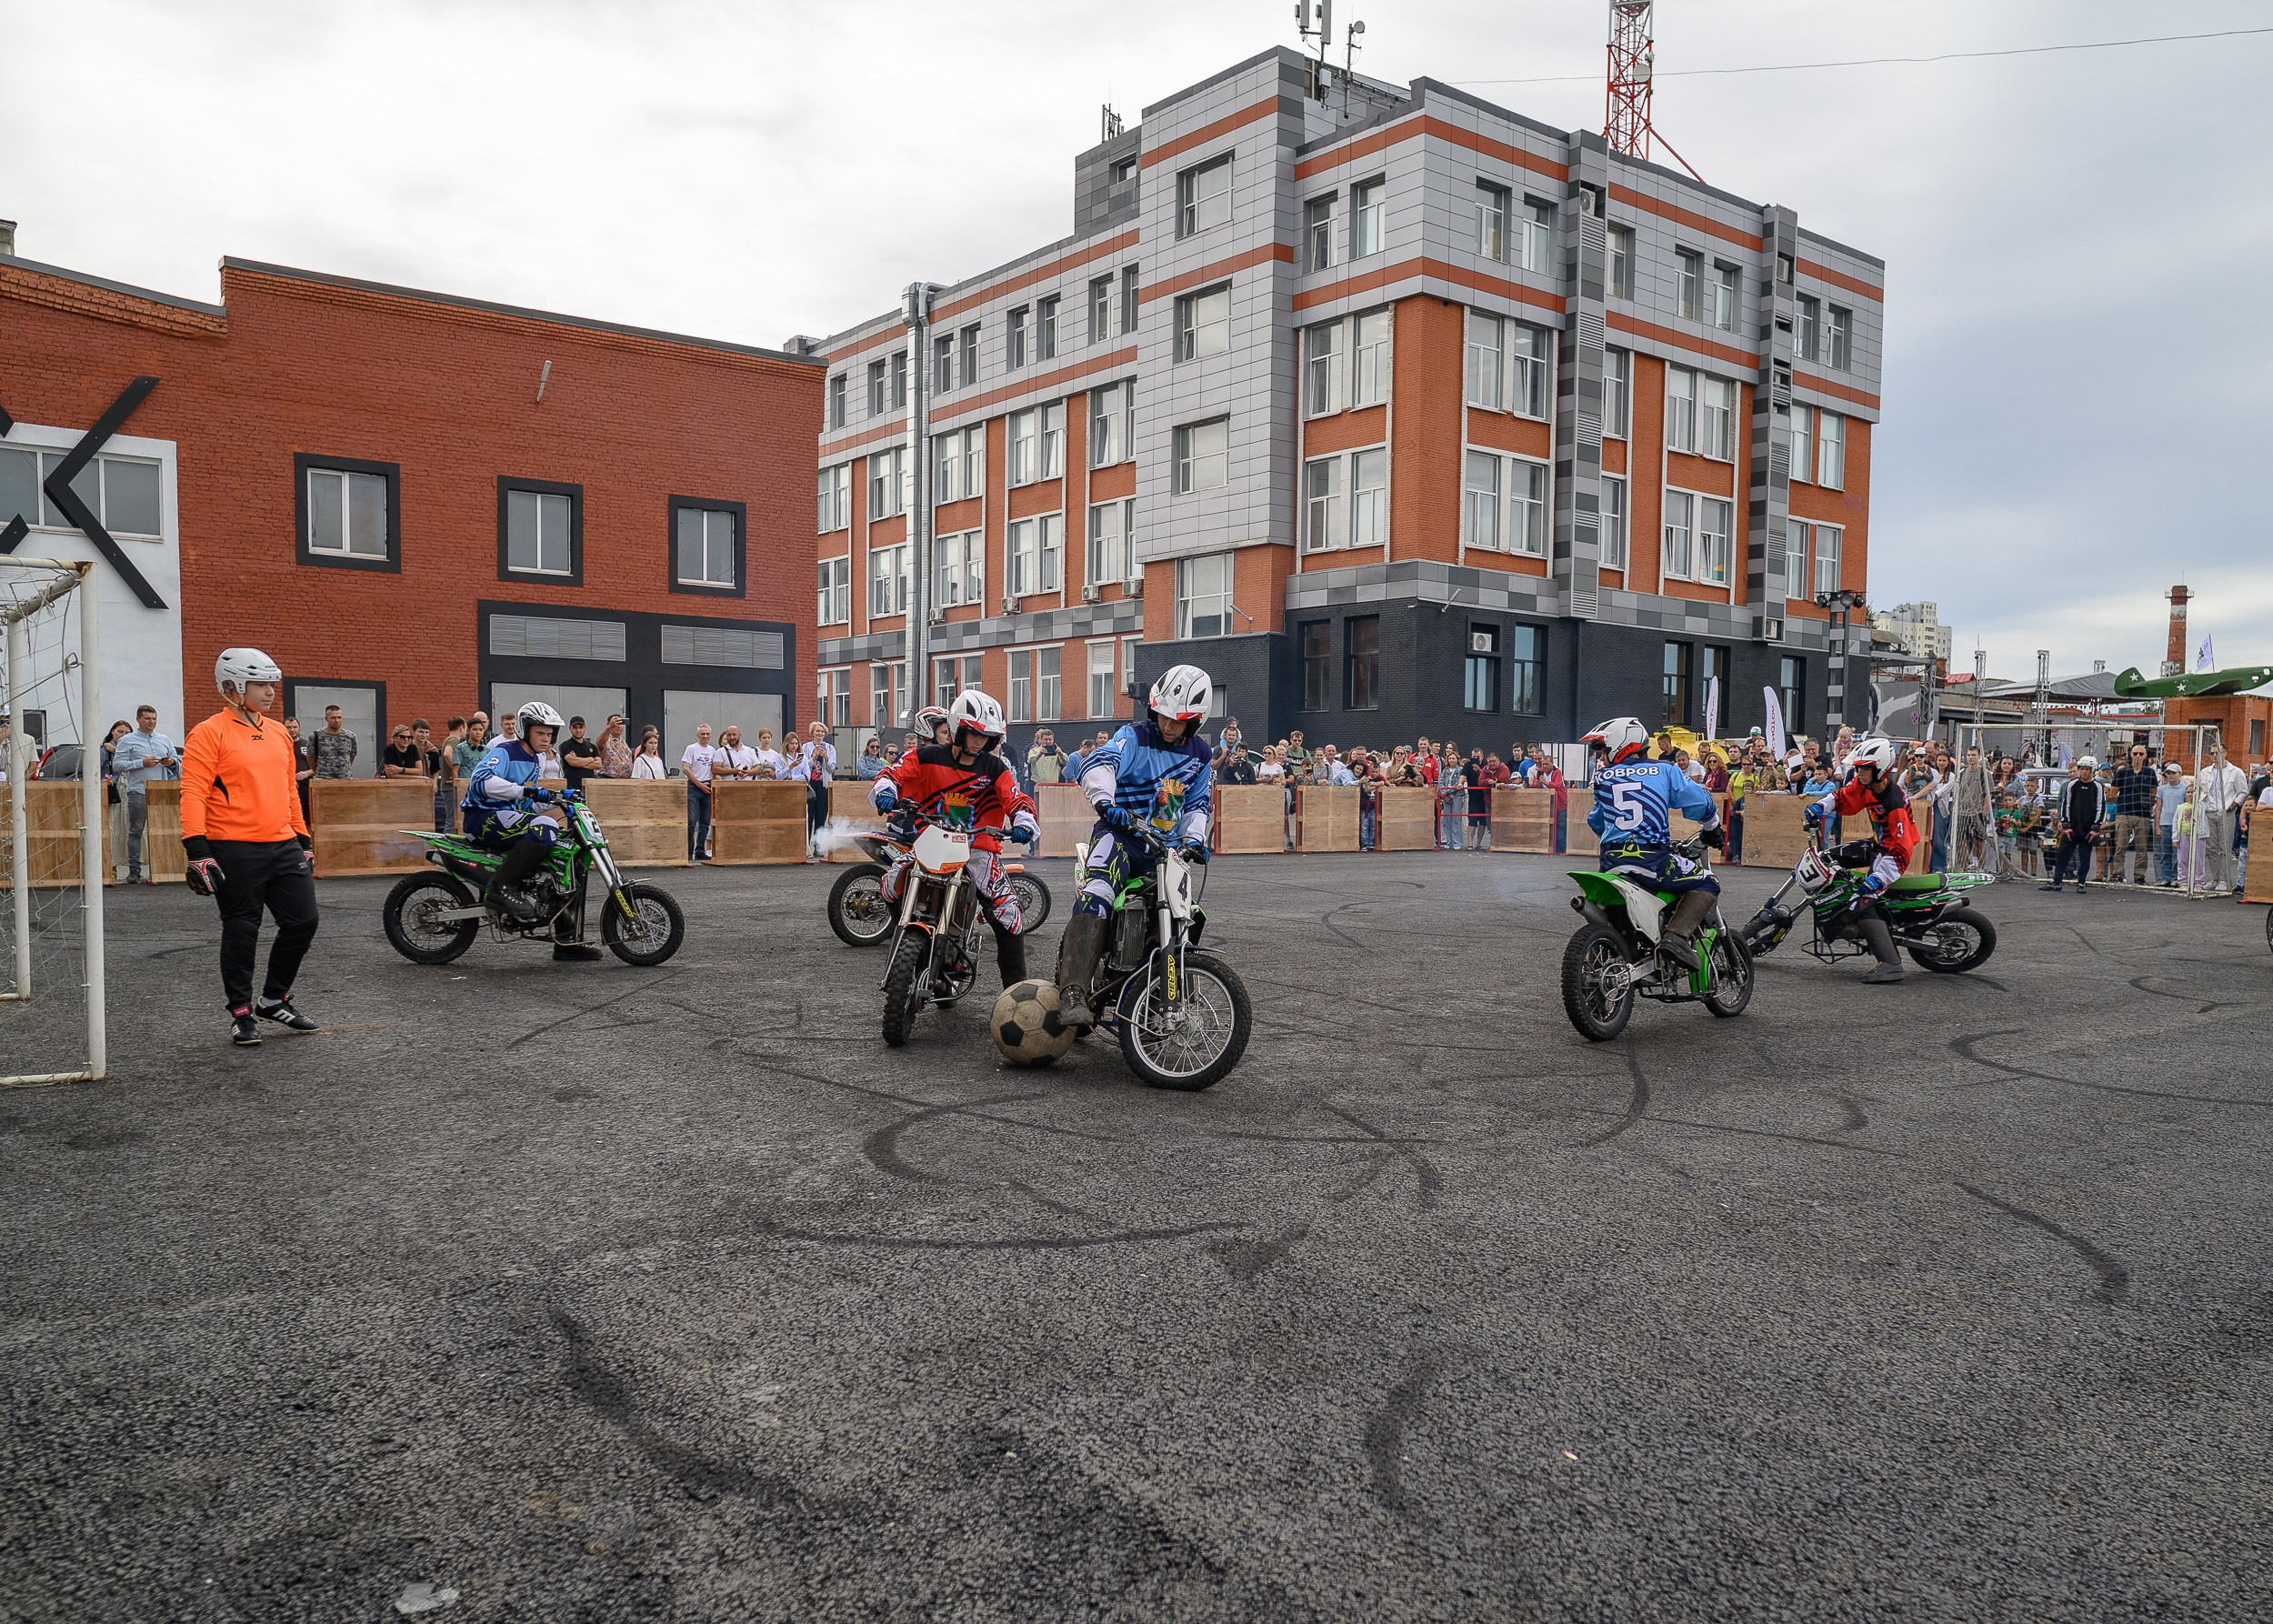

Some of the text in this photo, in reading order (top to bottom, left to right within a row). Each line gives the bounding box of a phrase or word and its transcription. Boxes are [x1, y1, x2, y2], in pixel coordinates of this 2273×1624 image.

[1594, 767, 1659, 785] КОВРОВ
[1611, 782, 1644, 831] 5
[1897, 821, 1905, 838] 3
[1799, 863, 1820, 883] 3
[1177, 871, 1187, 901] 4
[1814, 887, 1845, 906] Kawasaki
[1167, 954, 1176, 1000] ACERBIS
